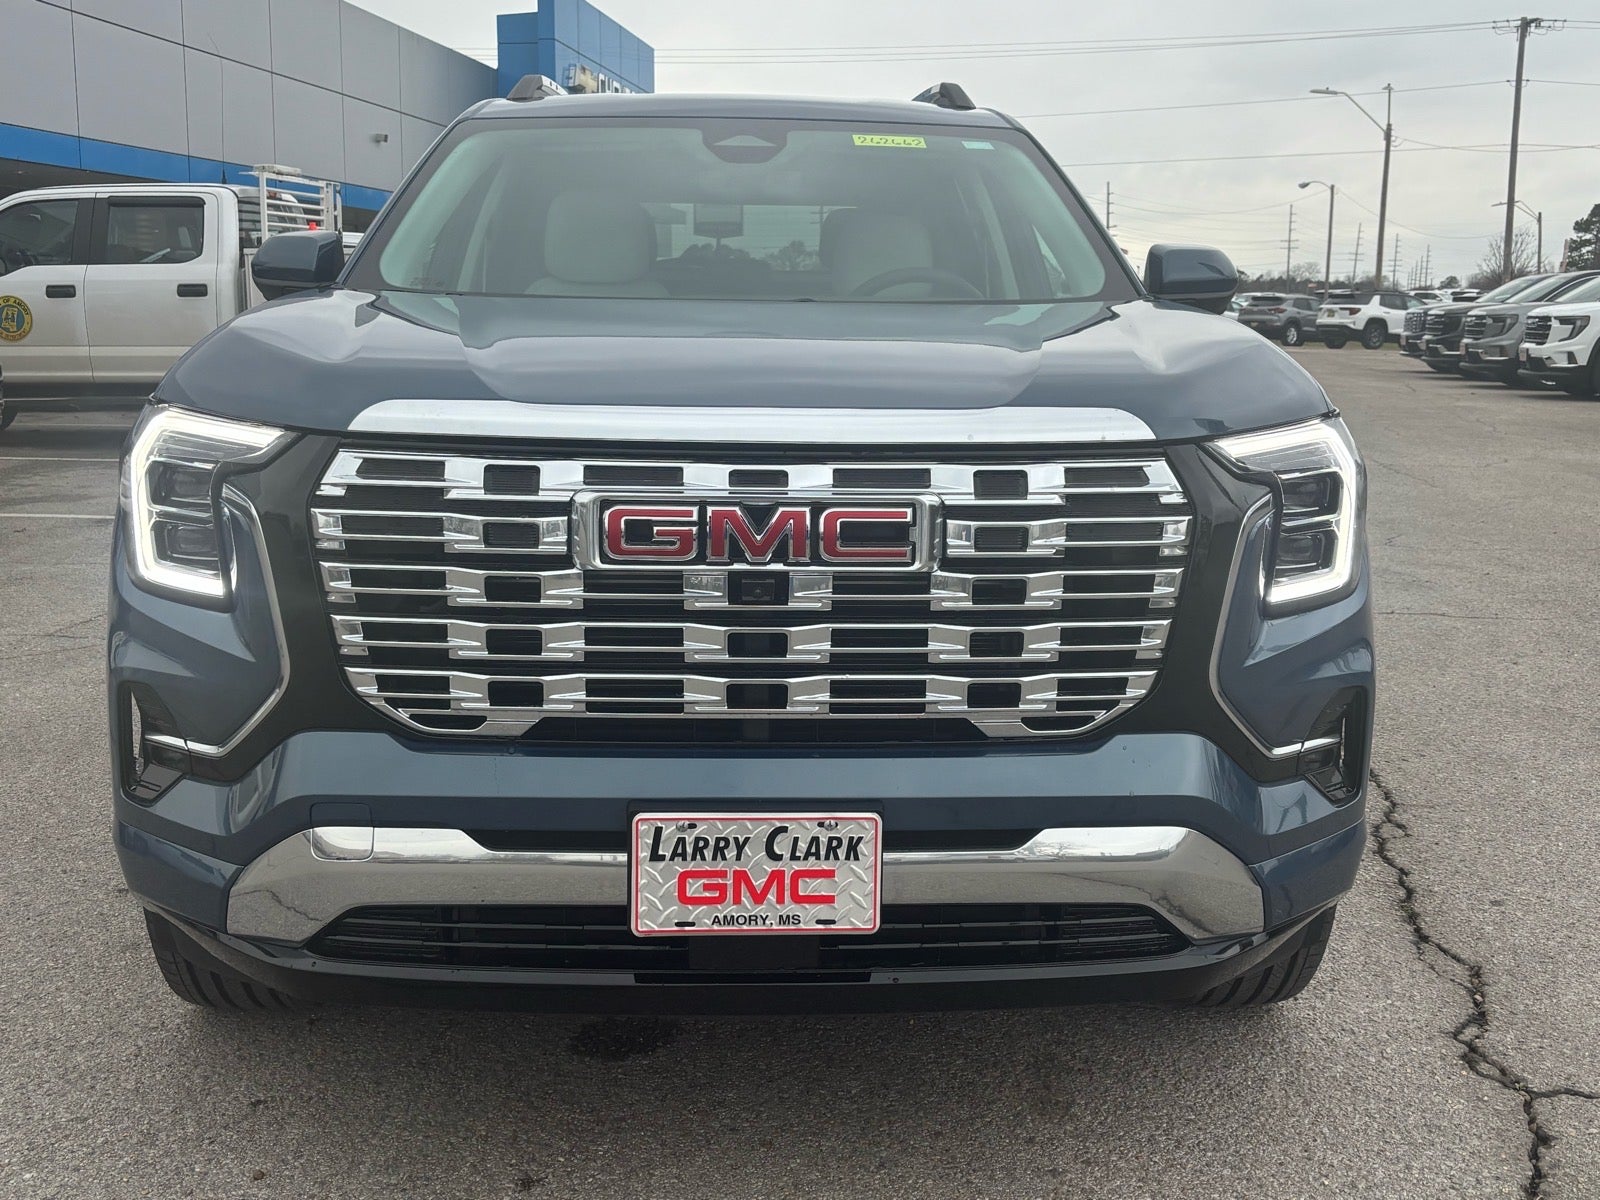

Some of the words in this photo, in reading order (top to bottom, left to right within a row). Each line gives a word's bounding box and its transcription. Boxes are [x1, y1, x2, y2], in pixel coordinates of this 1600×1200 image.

[603, 505, 913, 562] GMC
[648, 825, 751, 863] LARRY
[764, 825, 864, 862] CLARK
[677, 868, 837, 906] GMC
[711, 914, 774, 927] AMORY,
[778, 914, 802, 926] MS
